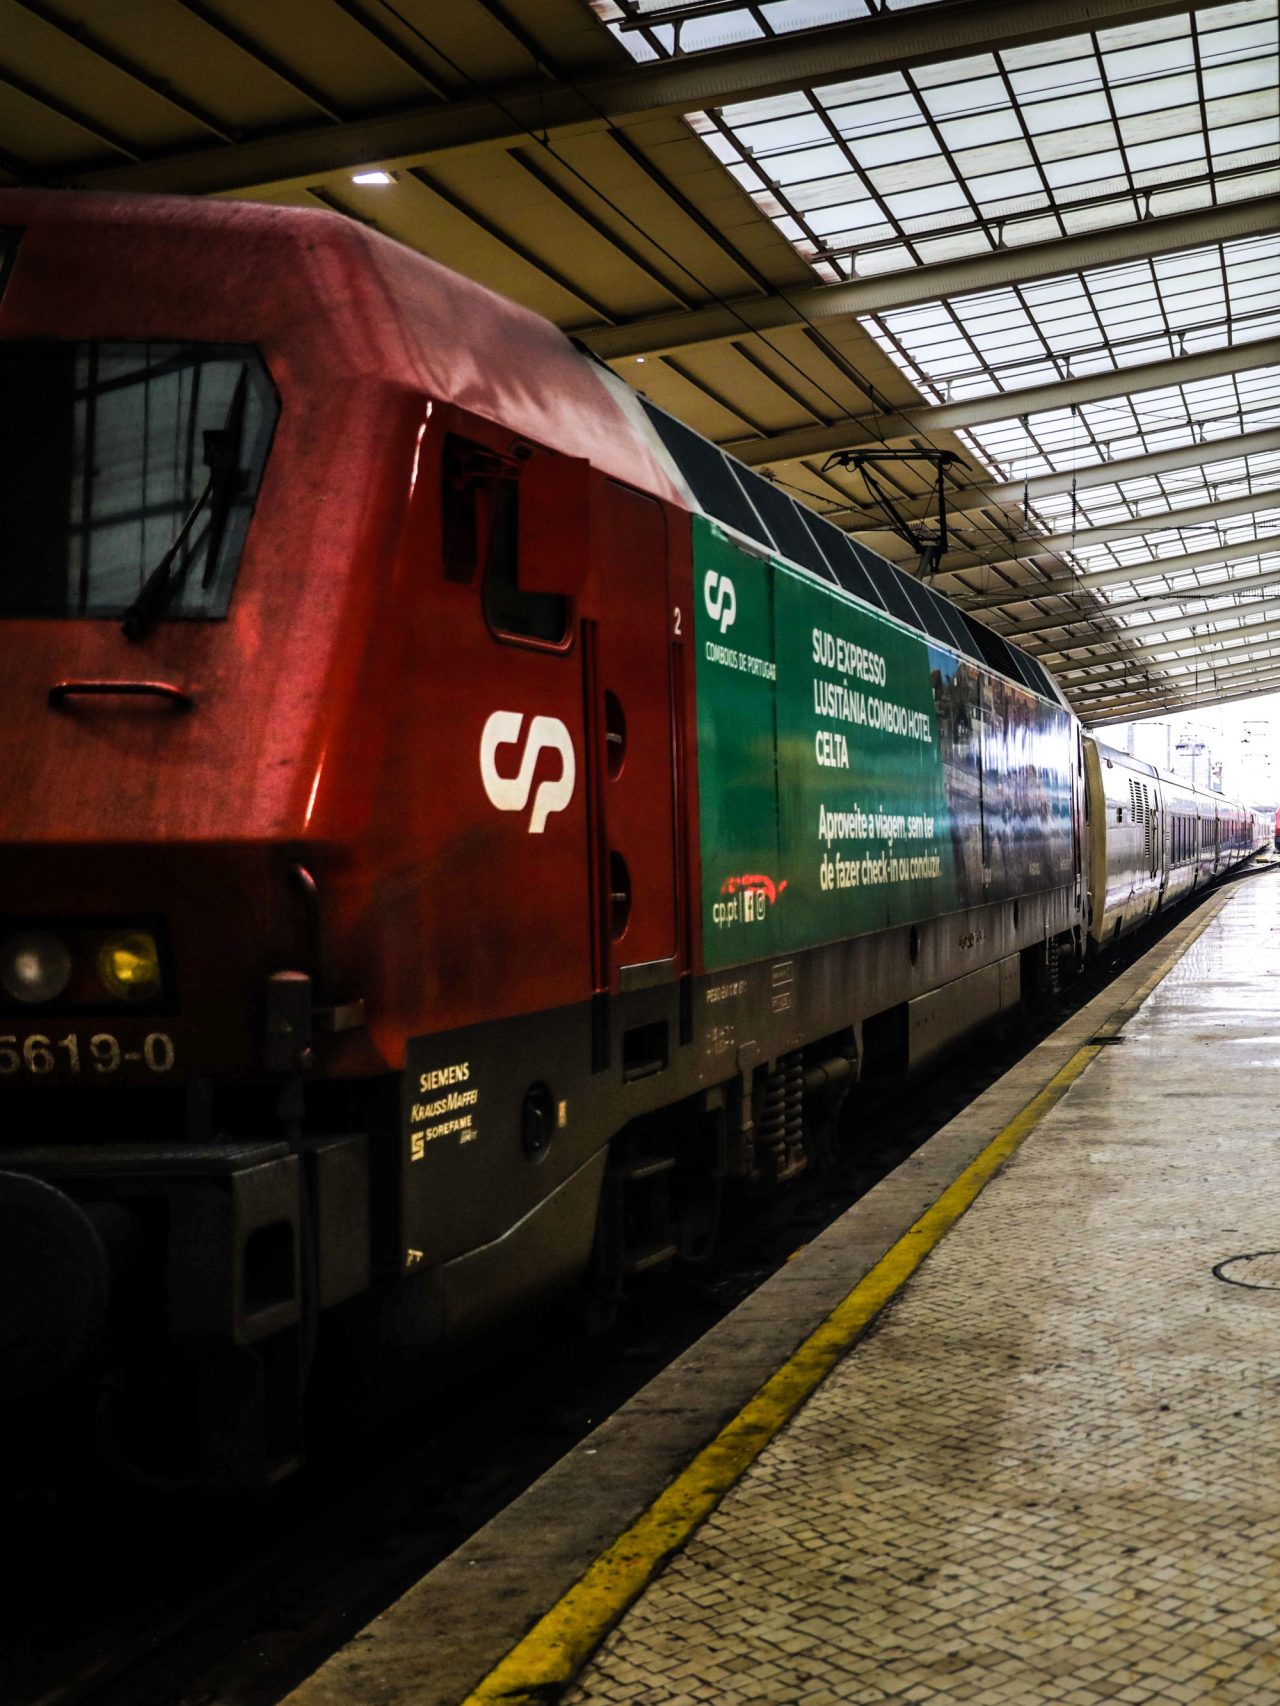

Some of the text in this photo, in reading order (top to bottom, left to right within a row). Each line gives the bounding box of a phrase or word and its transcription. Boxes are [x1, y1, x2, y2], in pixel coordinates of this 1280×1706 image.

[673, 607, 682, 635] 2
[705, 641, 738, 669] COMBOIOS
[739, 652, 748, 672] DE
[812, 627, 887, 688] SUD EXPRESSO
[814, 678, 933, 743] LUSITÂNIA COMBOIO HOTEL
[815, 730, 850, 769] CELTA
[818, 802, 867, 849] Aproveite
[868, 813, 875, 839] a
[907, 815, 924, 839] sem
[923, 812, 934, 839] ter
[820, 853, 835, 891] de
[835, 852, 860, 889] fazer
[861, 848, 899, 886] check-in
[899, 858, 910, 881] ou
[0, 1032, 175, 1073] 5619-0
[420, 1062, 470, 1093] SIEMENS
[425, 1115, 472, 1141] SOREFAME
